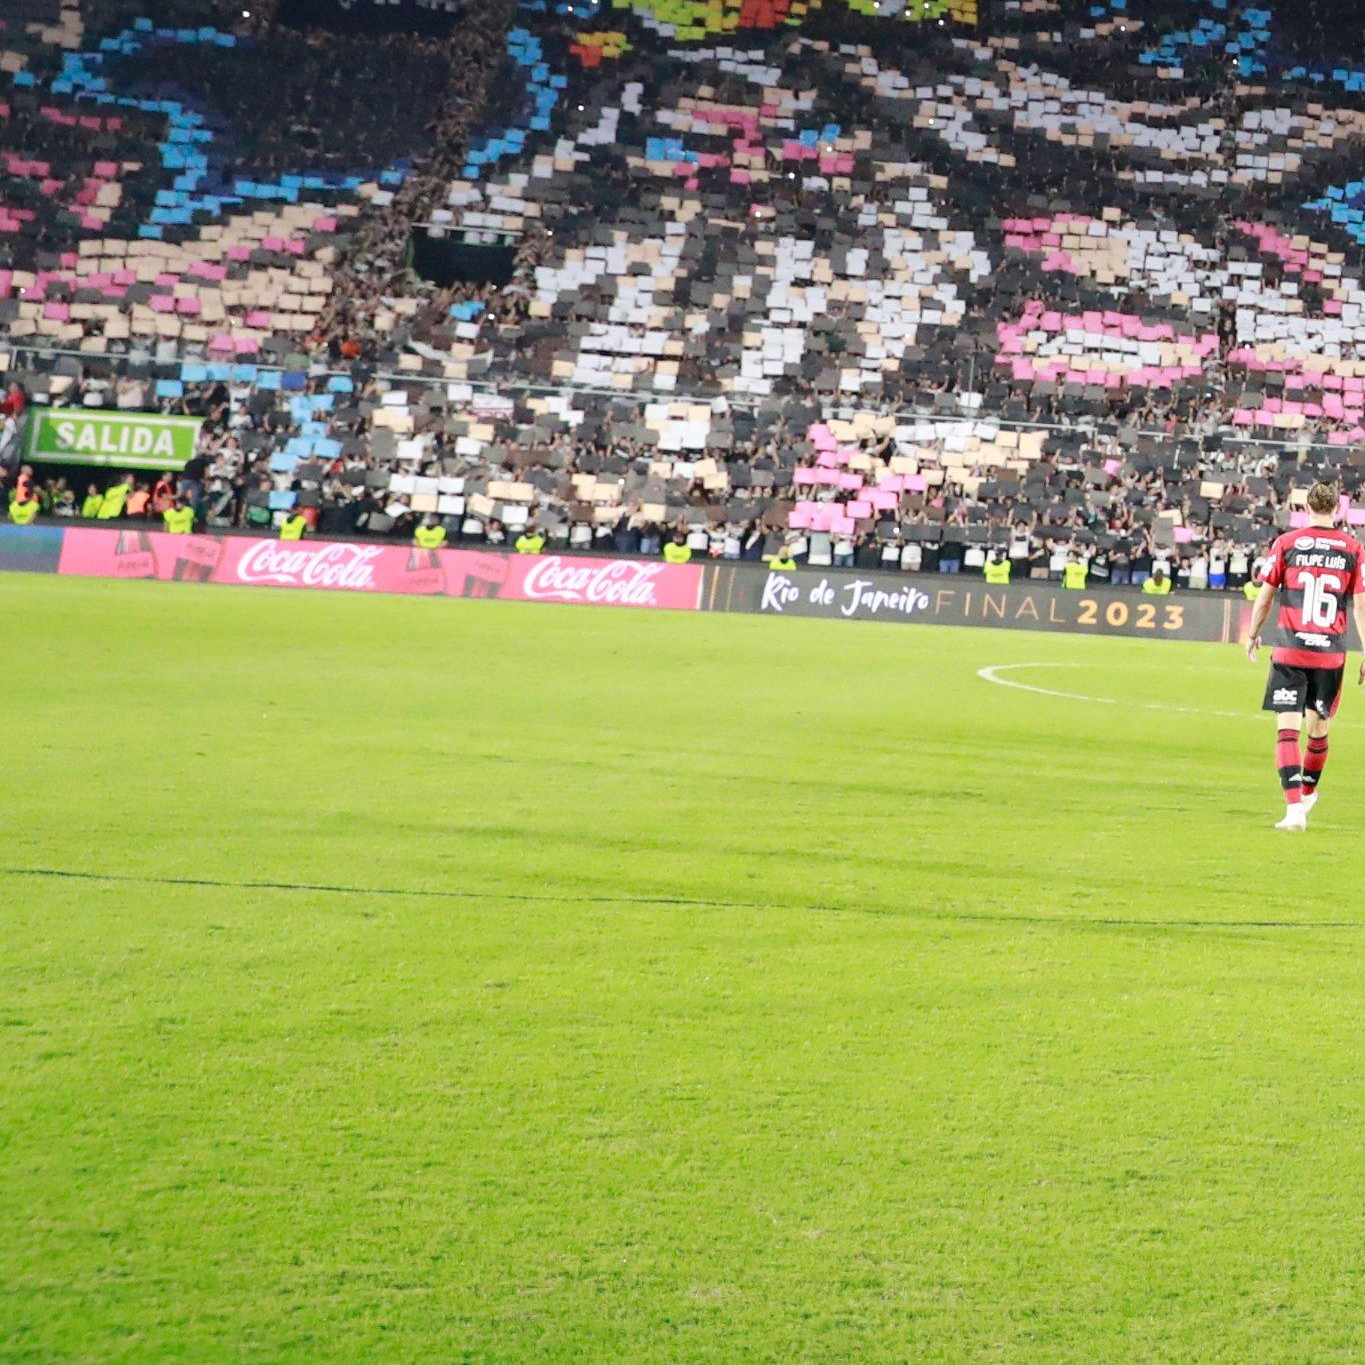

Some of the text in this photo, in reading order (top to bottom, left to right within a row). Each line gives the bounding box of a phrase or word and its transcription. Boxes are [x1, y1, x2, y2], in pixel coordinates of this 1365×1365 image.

[55, 421, 174, 457] SALIDA
[236, 538, 384, 588] Coca-Cola
[523, 555, 665, 605] Coca-Cola
[1296, 554, 1346, 570] FILIPE LUÍS
[760, 572, 1185, 631] Rio de Janeiro FINAL 2023
[1297, 571, 1341, 628] 16
[1272, 687, 1298, 701] abc
